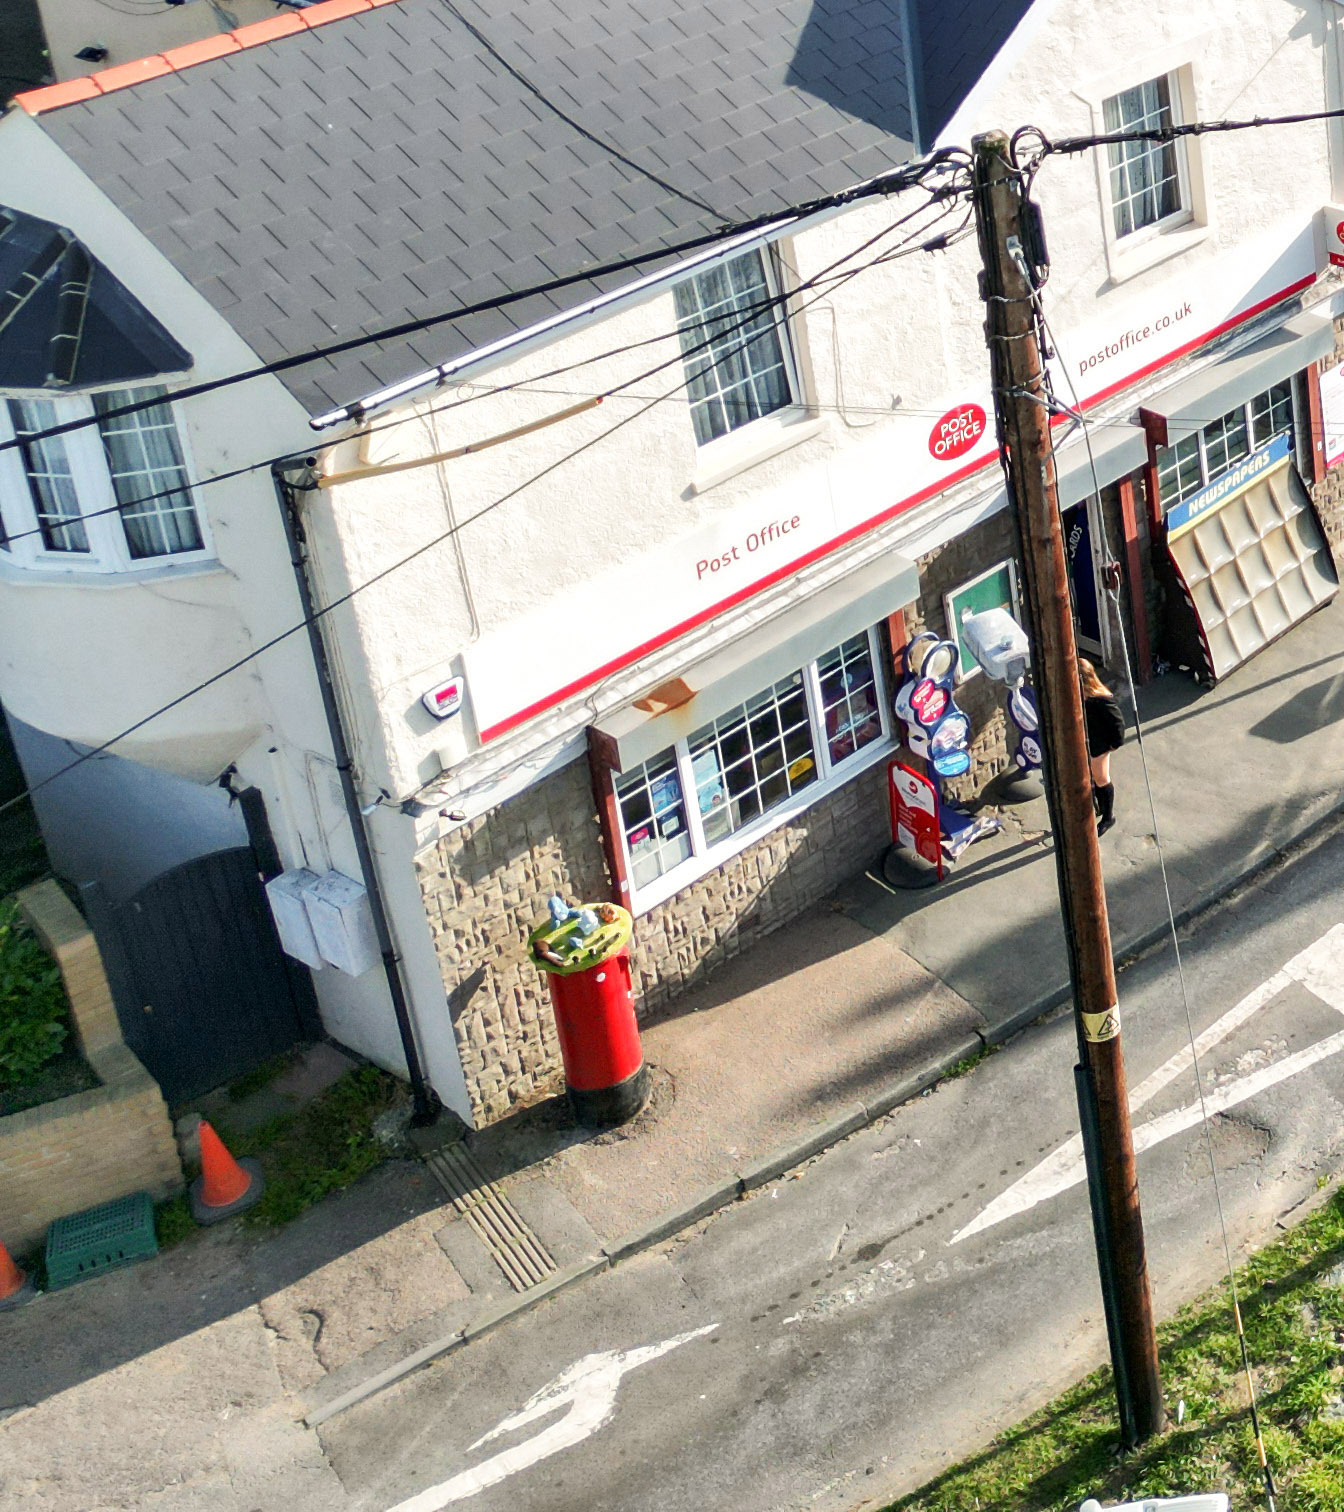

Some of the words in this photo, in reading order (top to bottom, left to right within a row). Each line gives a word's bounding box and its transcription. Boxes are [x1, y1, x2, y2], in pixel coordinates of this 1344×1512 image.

[1078, 301, 1193, 377] postoffice.co.uk
[934, 420, 982, 455] OFFICE
[940, 409, 974, 438] POST
[1188, 449, 1271, 518] NEWSPAPERS
[695, 545, 741, 581] Post
[746, 514, 801, 553] Office
